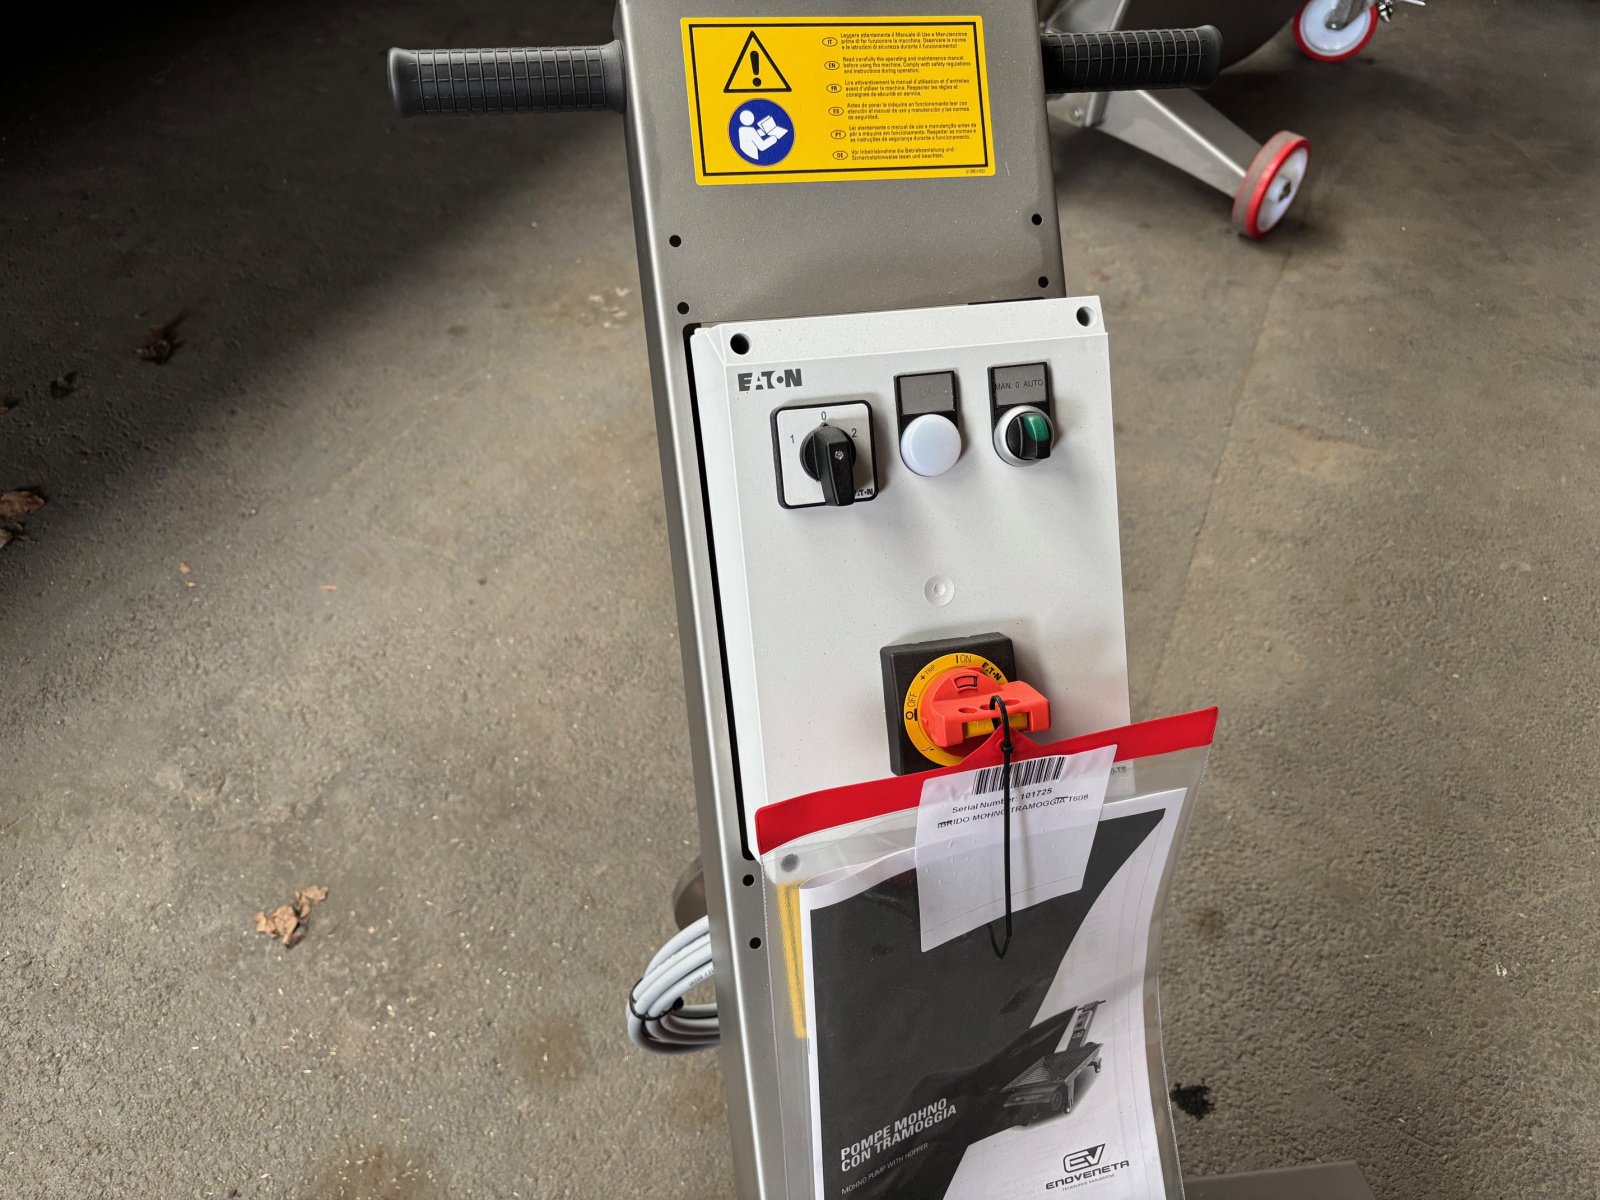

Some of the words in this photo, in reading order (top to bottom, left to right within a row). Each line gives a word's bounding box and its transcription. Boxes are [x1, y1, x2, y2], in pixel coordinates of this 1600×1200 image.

[738, 368, 802, 392] EATON
[1024, 379, 1044, 388] AUTO
[821, 411, 826, 420] 0
[790, 434, 795, 444] 1
[851, 428, 857, 438] 2
[960, 654, 972, 664] ON
[982, 662, 1002, 681] EATON
[907, 692, 918, 708] OFF
[952, 803, 978, 814] Serial
[1021, 787, 1052, 800] 101725
[1011, 797, 1066, 813] TRAMOGGIA
[840, 1125, 891, 1161] POMPE
[894, 1098, 947, 1133] MOHNO
[841, 1148, 871, 1172] CON
[874, 1104, 957, 1154] TRAMOGGIA
[841, 1176, 867, 1195] MOHNO
[868, 1165, 887, 1181] PUMP
[886, 1156, 904, 1169] WITH
[905, 1142, 929, 1160] HOPPER
